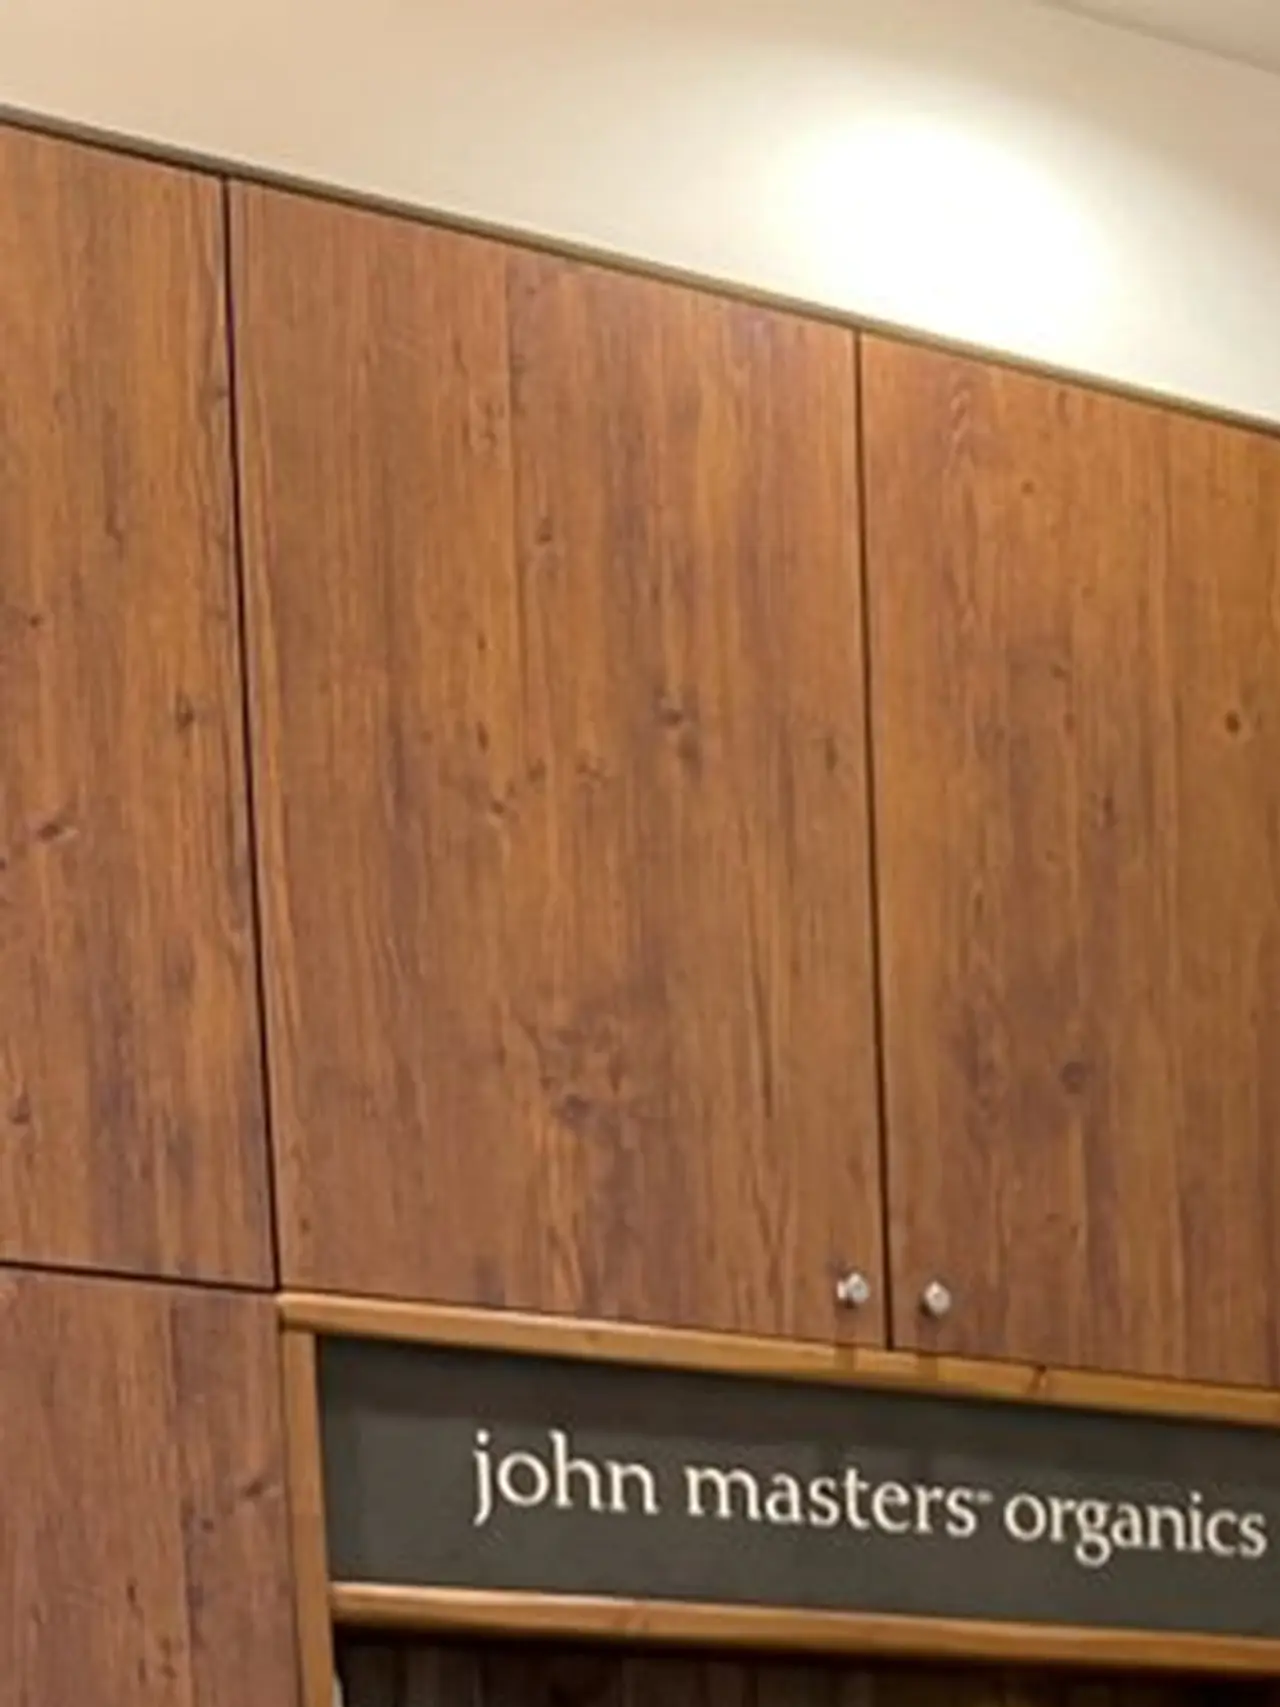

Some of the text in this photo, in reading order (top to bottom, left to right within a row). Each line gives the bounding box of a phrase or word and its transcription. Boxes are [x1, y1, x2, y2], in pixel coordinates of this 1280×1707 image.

[472, 1428, 1268, 1567] john masters organics
